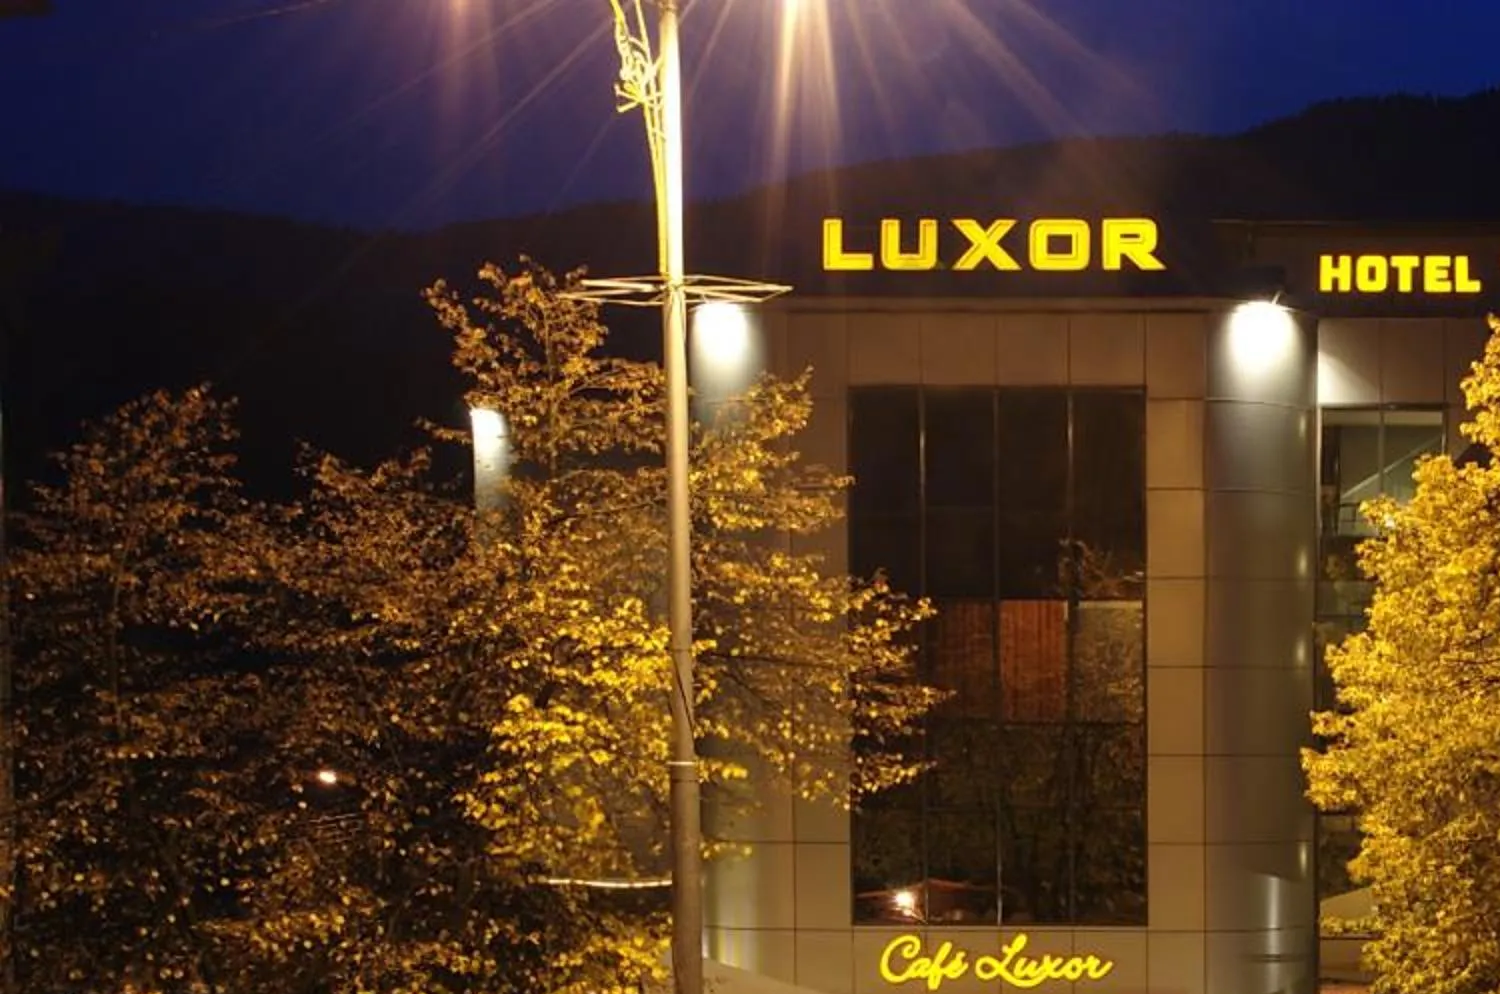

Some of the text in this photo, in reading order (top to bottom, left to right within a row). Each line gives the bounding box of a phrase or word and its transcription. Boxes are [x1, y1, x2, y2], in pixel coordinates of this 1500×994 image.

[823, 218, 1167, 271] LUXOR
[1319, 254, 1482, 293] HOTEL
[975, 933, 1113, 988] Luxor
